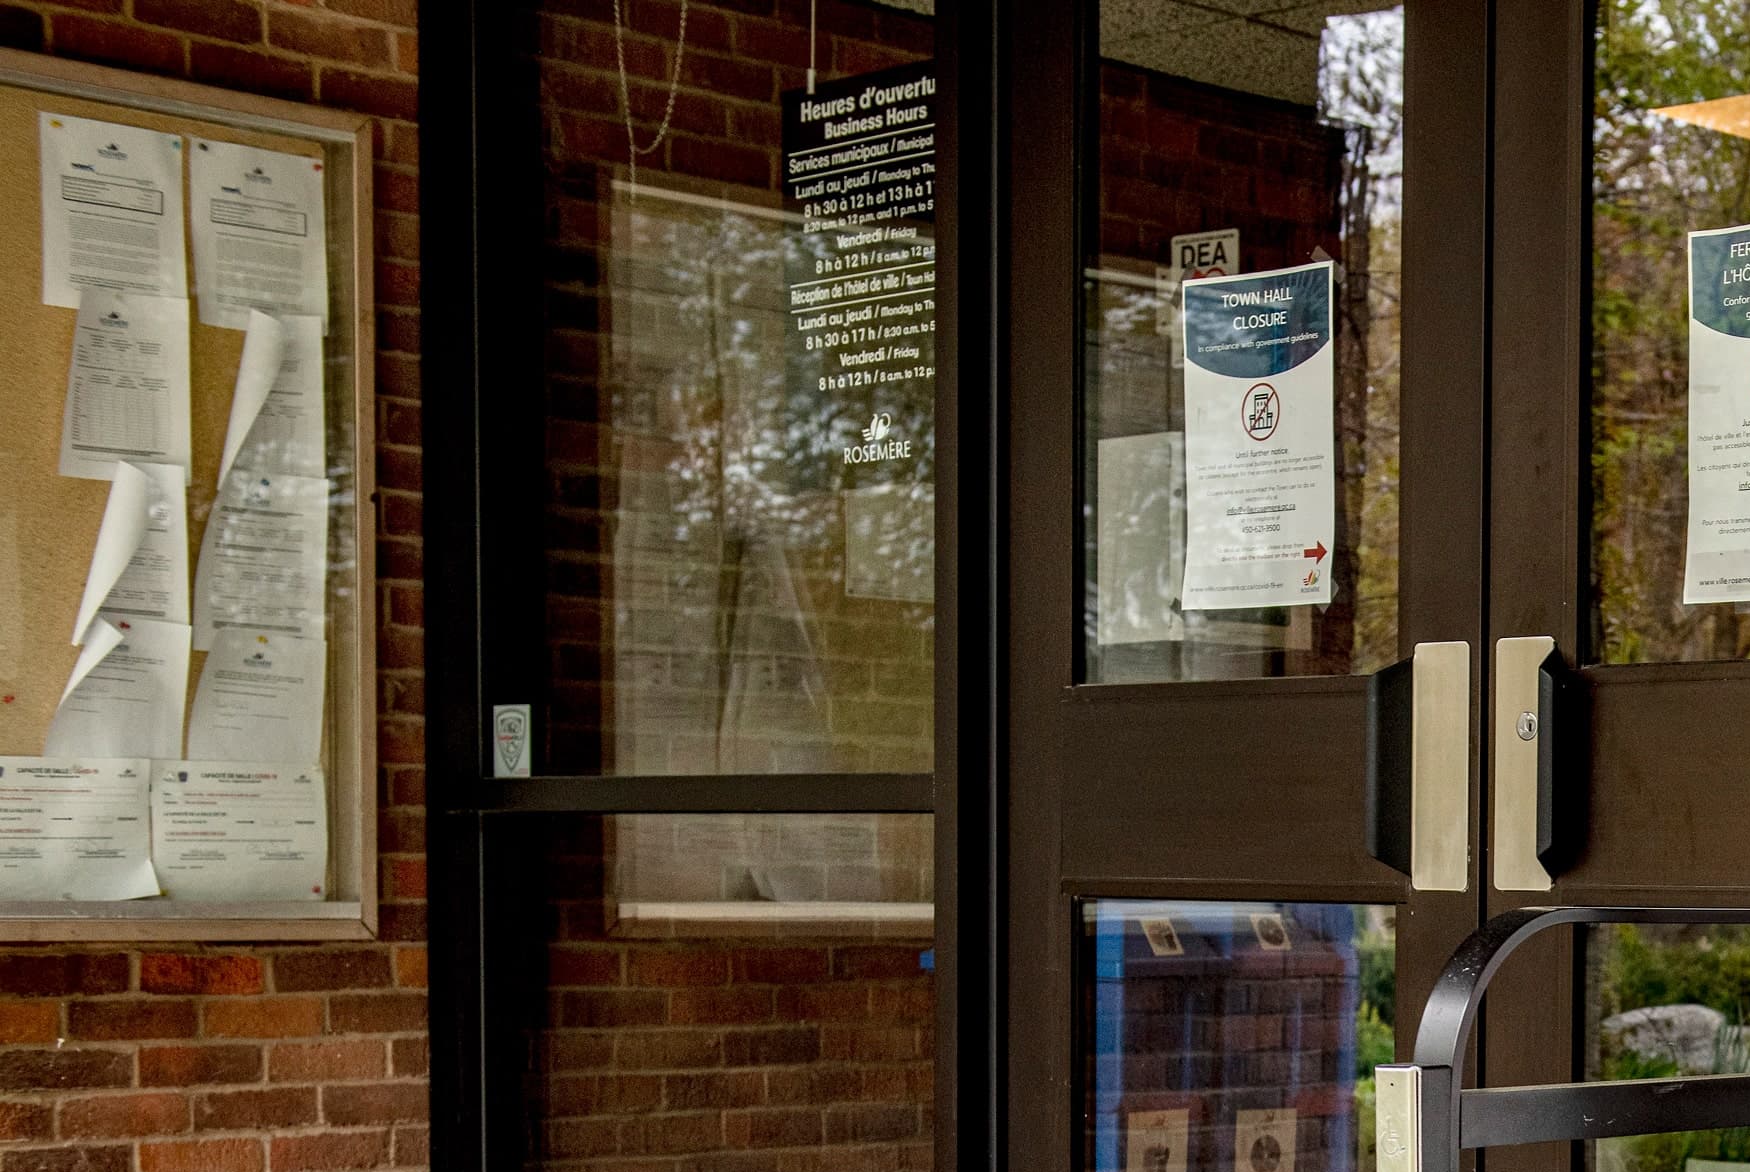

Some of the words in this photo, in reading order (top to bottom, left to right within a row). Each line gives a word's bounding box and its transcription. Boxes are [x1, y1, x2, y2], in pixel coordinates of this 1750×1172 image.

[801, 96, 855, 122] Heures
[860, 76, 936, 109] d'ouvertu
[824, 115, 883, 139] Business
[886, 106, 928, 126] Hours
[789, 156, 830, 174] Services
[832, 144, 888, 165] municipaux
[796, 181, 824, 199] Lundi
[827, 182, 840, 192] au
[840, 171, 870, 193] jeudi
[837, 227, 882, 248] Vendredi
[1180, 241, 1227, 270] DEA
[832, 286, 842, 298] de
[870, 278, 880, 290] de
[883, 274, 899, 288] ville
[1222, 292, 1260, 308] TOWN
[1264, 287, 1293, 304] HALL
[798, 313, 826, 330] Lundi
[829, 314, 842, 324] au
[843, 306, 872, 326] jeudi
[1233, 311, 1287, 330] CLOSURE
[840, 348, 884, 366] Vendredi
[894, 347, 919, 359] Friday
[844, 440, 910, 464] ROSEMÈRE
